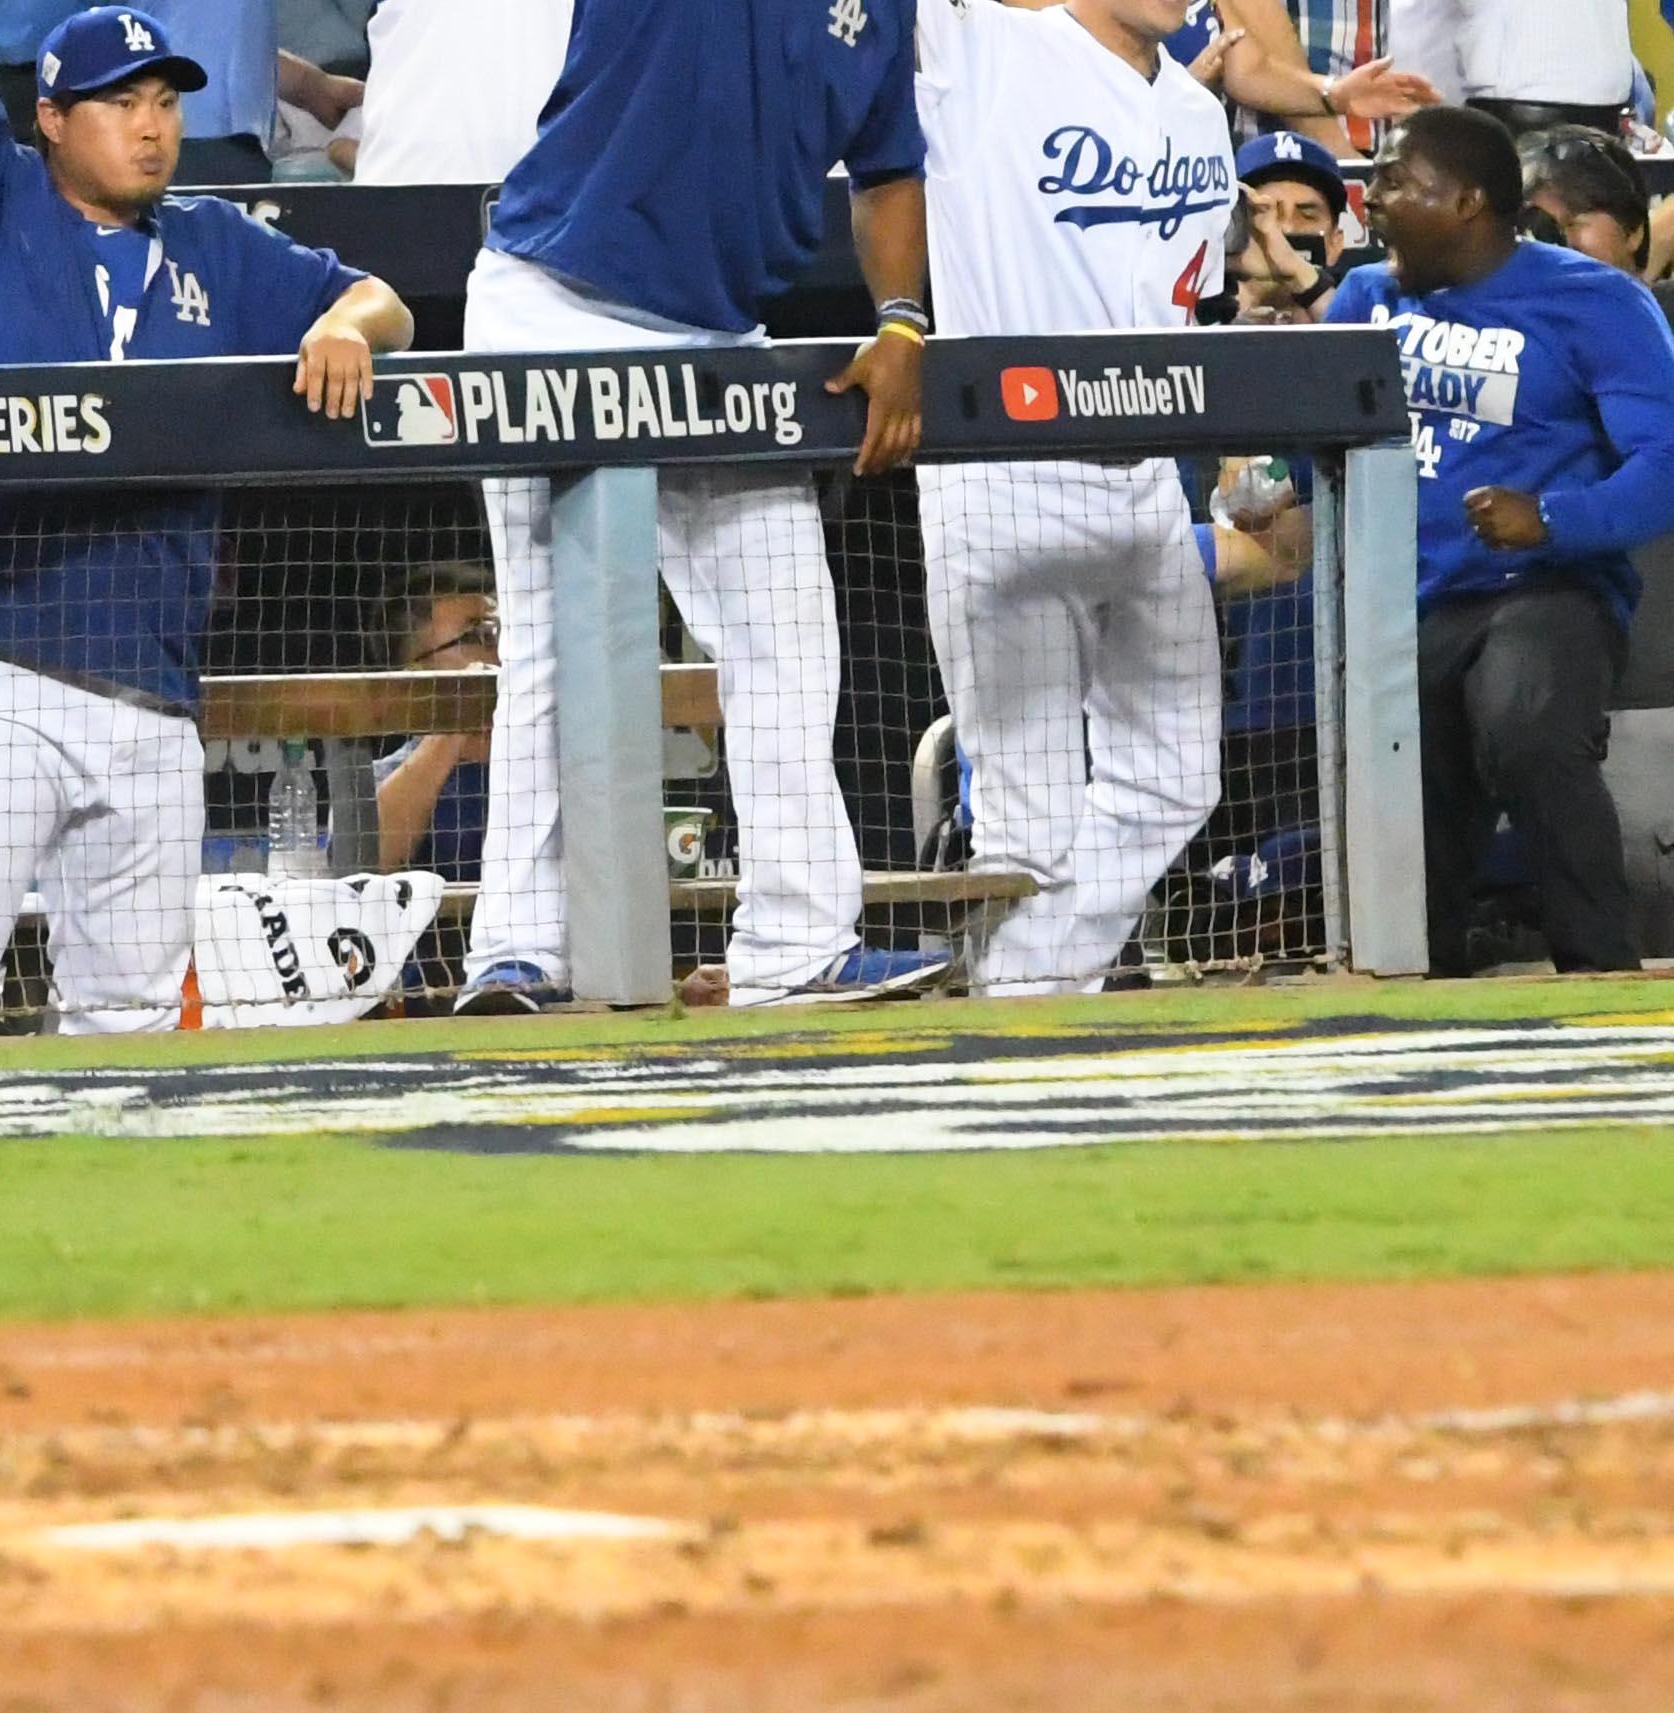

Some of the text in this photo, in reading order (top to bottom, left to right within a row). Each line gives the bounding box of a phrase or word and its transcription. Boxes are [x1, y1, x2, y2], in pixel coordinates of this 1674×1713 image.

[118, 14, 155, 51] LA
[1274, 132, 1302, 160] LA
[1038, 125, 1230, 241] Dodgers
[164, 256, 211, 327] LA
[1371, 304, 1525, 375] TOBER
[459, 363, 804, 446] PLAY BALL.org
